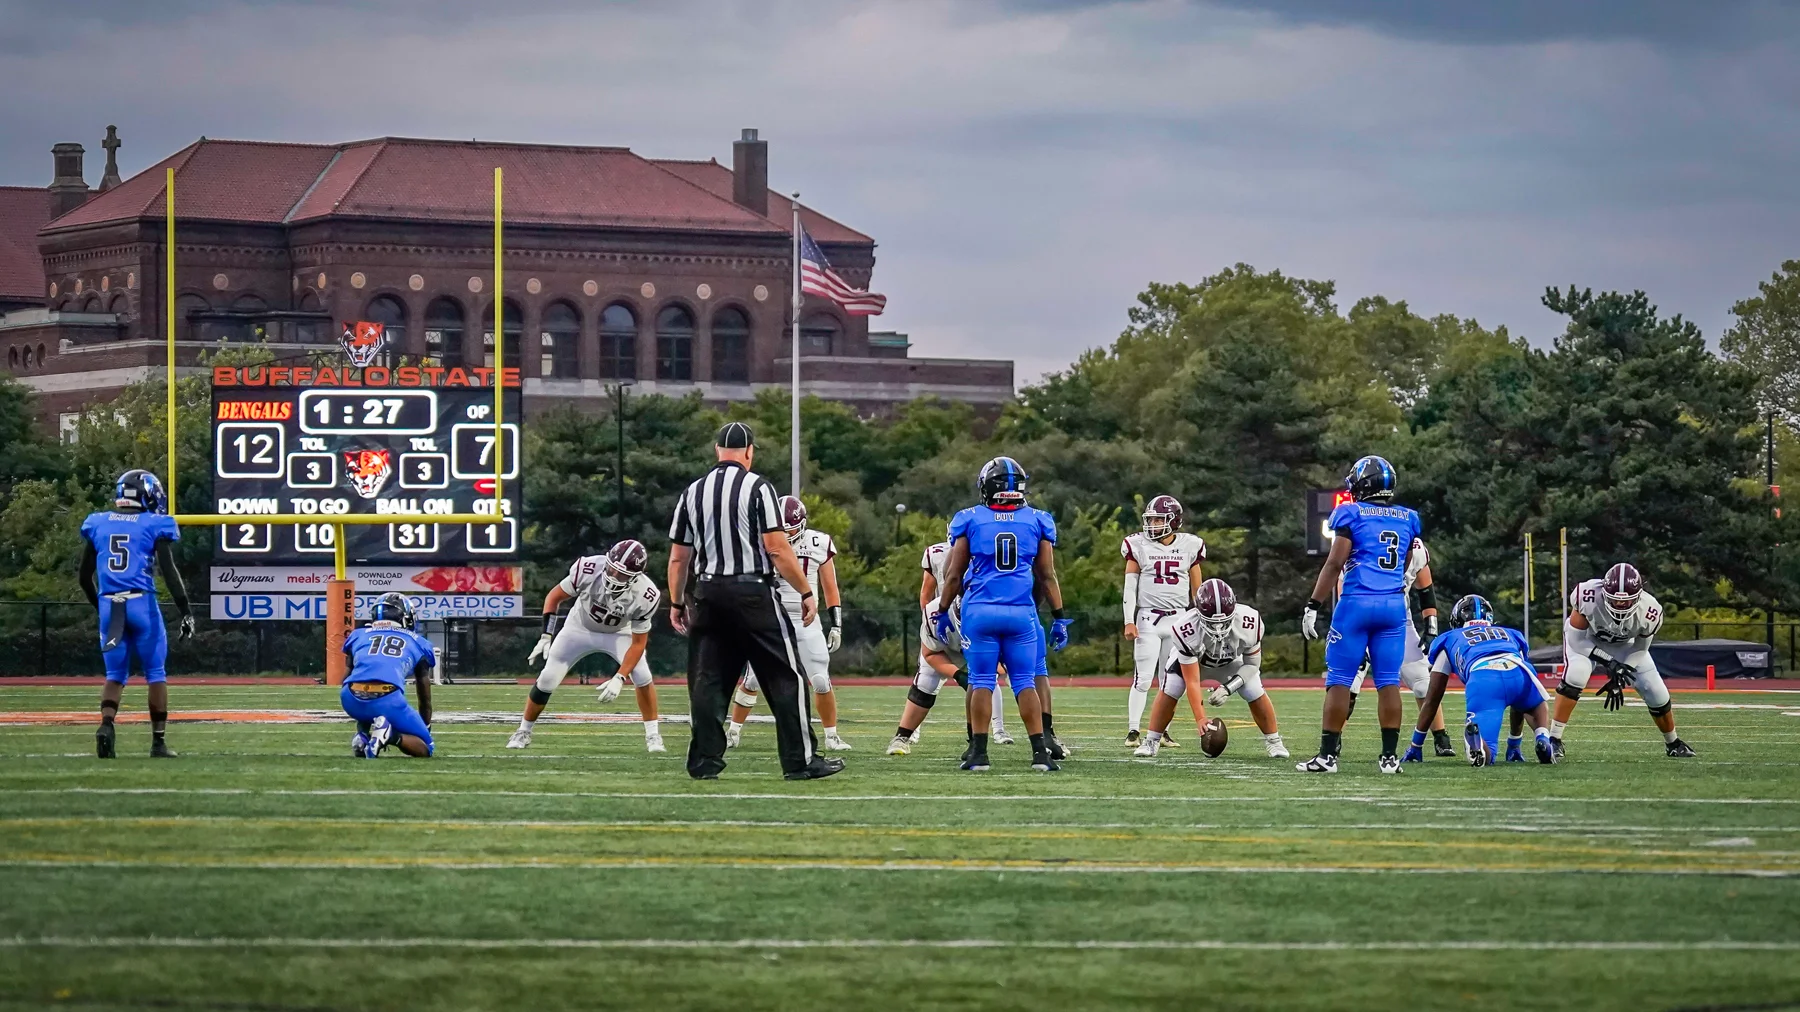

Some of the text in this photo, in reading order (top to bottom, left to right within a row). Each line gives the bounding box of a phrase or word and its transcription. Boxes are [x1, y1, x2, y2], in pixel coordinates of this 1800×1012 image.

[213, 366, 520, 387] BUFFALO STATE
[217, 401, 292, 420] BENGALS
[467, 405, 490, 419] OP
[233, 434, 273, 464] 12
[300, 438, 327, 451] TOL
[409, 438, 437, 451] TOL
[475, 436, 496, 466] 7
[306, 462, 320, 480] 3
[417, 462, 432, 480] 3
[218, 498, 278, 514] DOWN
[290, 498, 350, 514] TO GO
[376, 498, 453, 514] BALL ON
[1360, 507, 1409, 521] RIDGEWAY
[239, 524, 255, 545] 2
[305, 524, 335, 545] 10
[398, 524, 427, 546] 31
[484, 524, 498, 546] 1
[812, 536, 820, 547] C
[108, 534, 129, 572] 5
[995, 532, 1018, 572] 0
[1378, 530, 1399, 571] 3
[583, 562, 596, 575] 50
[1154, 561, 1179, 585] 15
[217, 568, 275, 589] Wegmans
[643, 587, 657, 602] 50
[1583, 589, 1596, 603] 55
[224, 596, 273, 618] UB
[1646, 606, 1658, 622] 55
[1180, 622, 1195, 639] 52
[1242, 615, 1255, 630] 52
[1462, 627, 1509, 646] 50
[368, 634, 406, 658] 18
